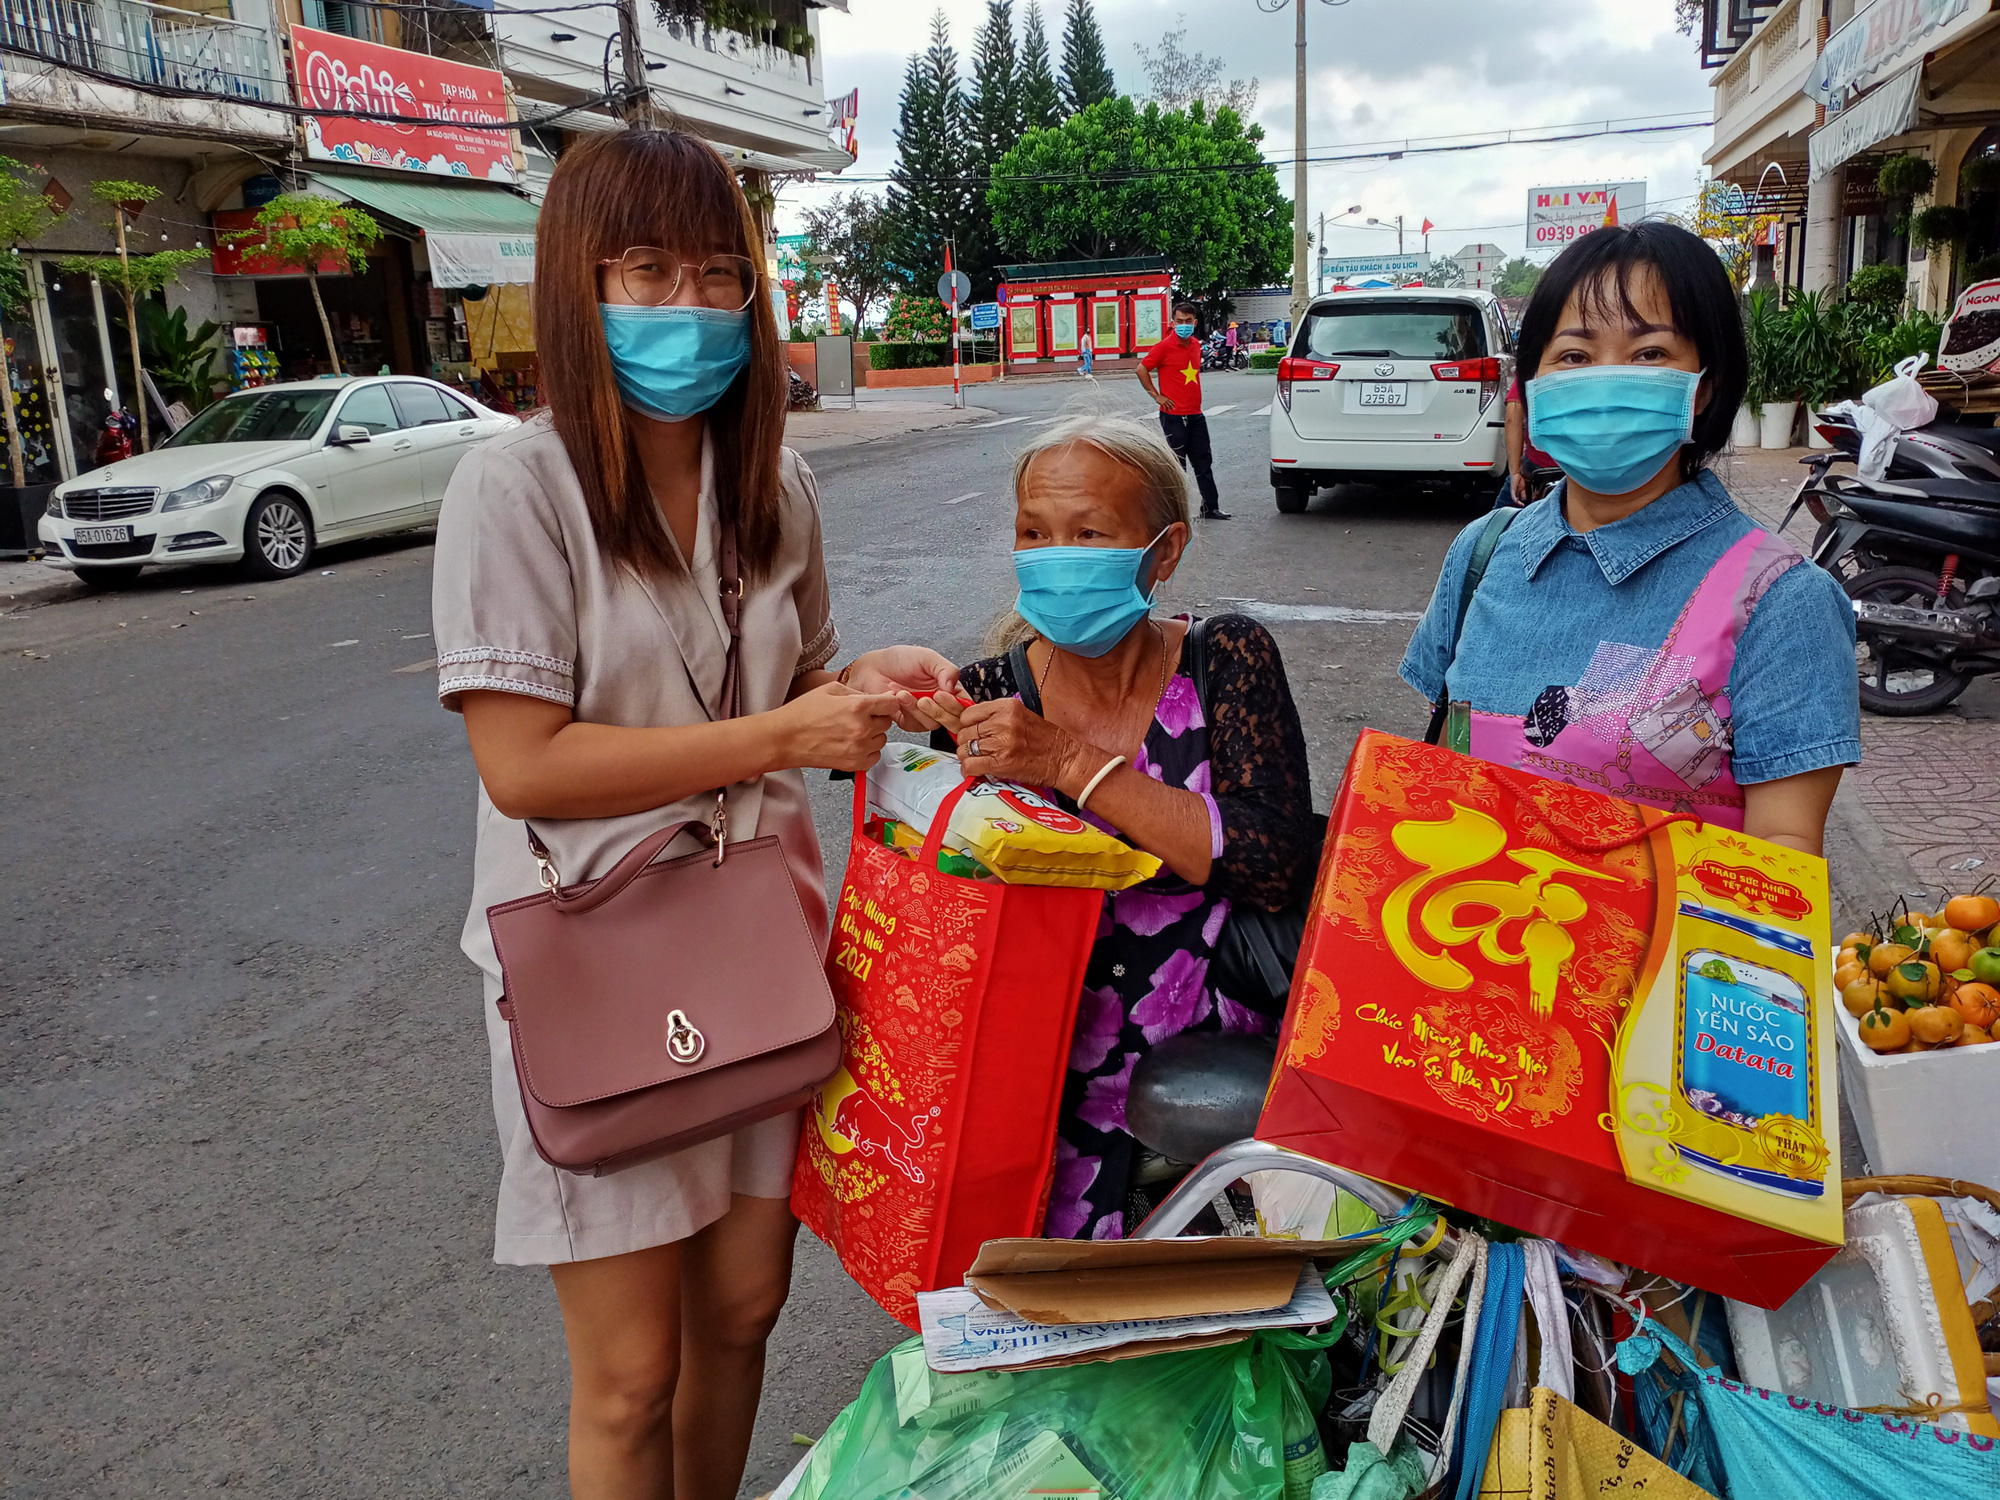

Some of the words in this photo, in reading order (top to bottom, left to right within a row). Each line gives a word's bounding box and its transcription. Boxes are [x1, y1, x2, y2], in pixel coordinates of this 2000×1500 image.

[306, 50, 400, 126] Oishi
[440, 82, 457, 99] TẠP
[458, 85, 478, 101] HÓA
[422, 100, 460, 122] THẢO
[1537, 193, 1570, 207] HAI
[1536, 225, 1574, 242] 0939
[1331, 263, 1344, 273] BẾN
[1360, 263, 1383, 272] KHÁCH
[1403, 261, 1418, 271] LỊCH
[1373, 384, 1394, 394] 65A
[1365, 394, 1402, 405] 275.87
[1709, 866, 1737, 880] TRAO
[1722, 879, 1742, 891] TẾT
[1744, 887, 1758, 896] AN
[864, 898, 896, 935] Mừng
[863, 928, 885, 954] Mới
[835, 941, 873, 982] 2021
[1355, 1003, 1404, 1030] Chúc
[1711, 992, 1780, 1028] NƯỚC
[1694, 1007, 1739, 1036] YẾN
[1746, 1024, 1795, 1052] SÀO
[1693, 1031, 1796, 1080] Datafa
[1382, 1040, 1417, 1069] Vạn
[1489, 1074, 1519, 1113] Ý
[1775, 1149, 1806, 1165] 100%
[973, 1324, 1053, 1337] QUAFINA
